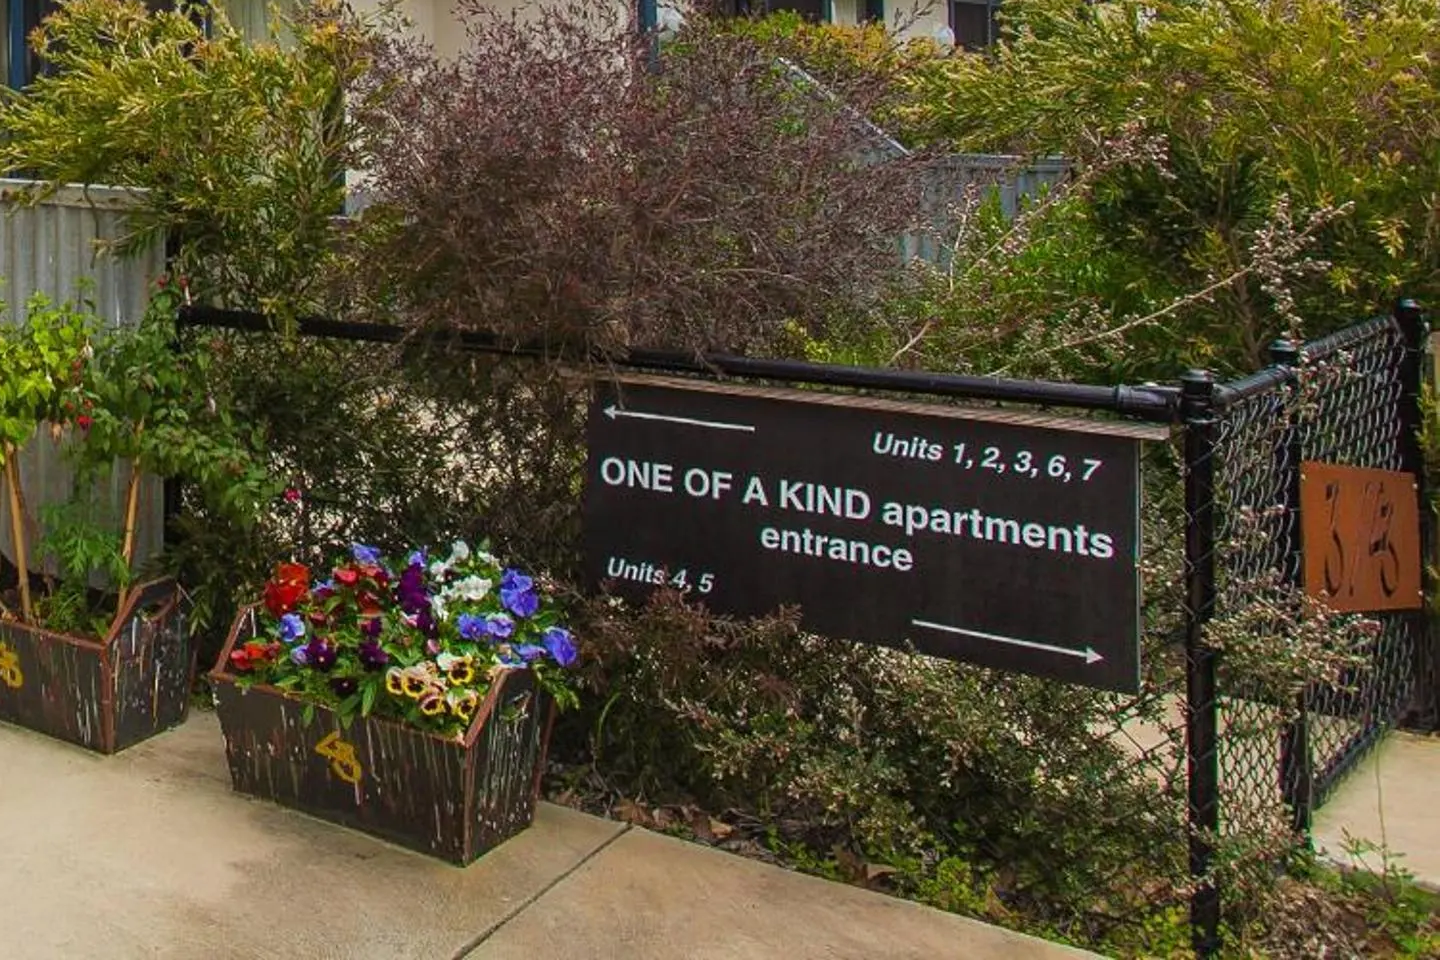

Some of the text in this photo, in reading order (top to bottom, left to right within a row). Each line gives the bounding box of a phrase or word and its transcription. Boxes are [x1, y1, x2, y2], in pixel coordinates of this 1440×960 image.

[872, 431, 1102, 483] Units 1, 2, 3, 6, 7
[601, 456, 1114, 559] ONE OF A KIND apartments
[760, 525, 914, 571] entrance
[607, 556, 715, 593] Units 4, 5
